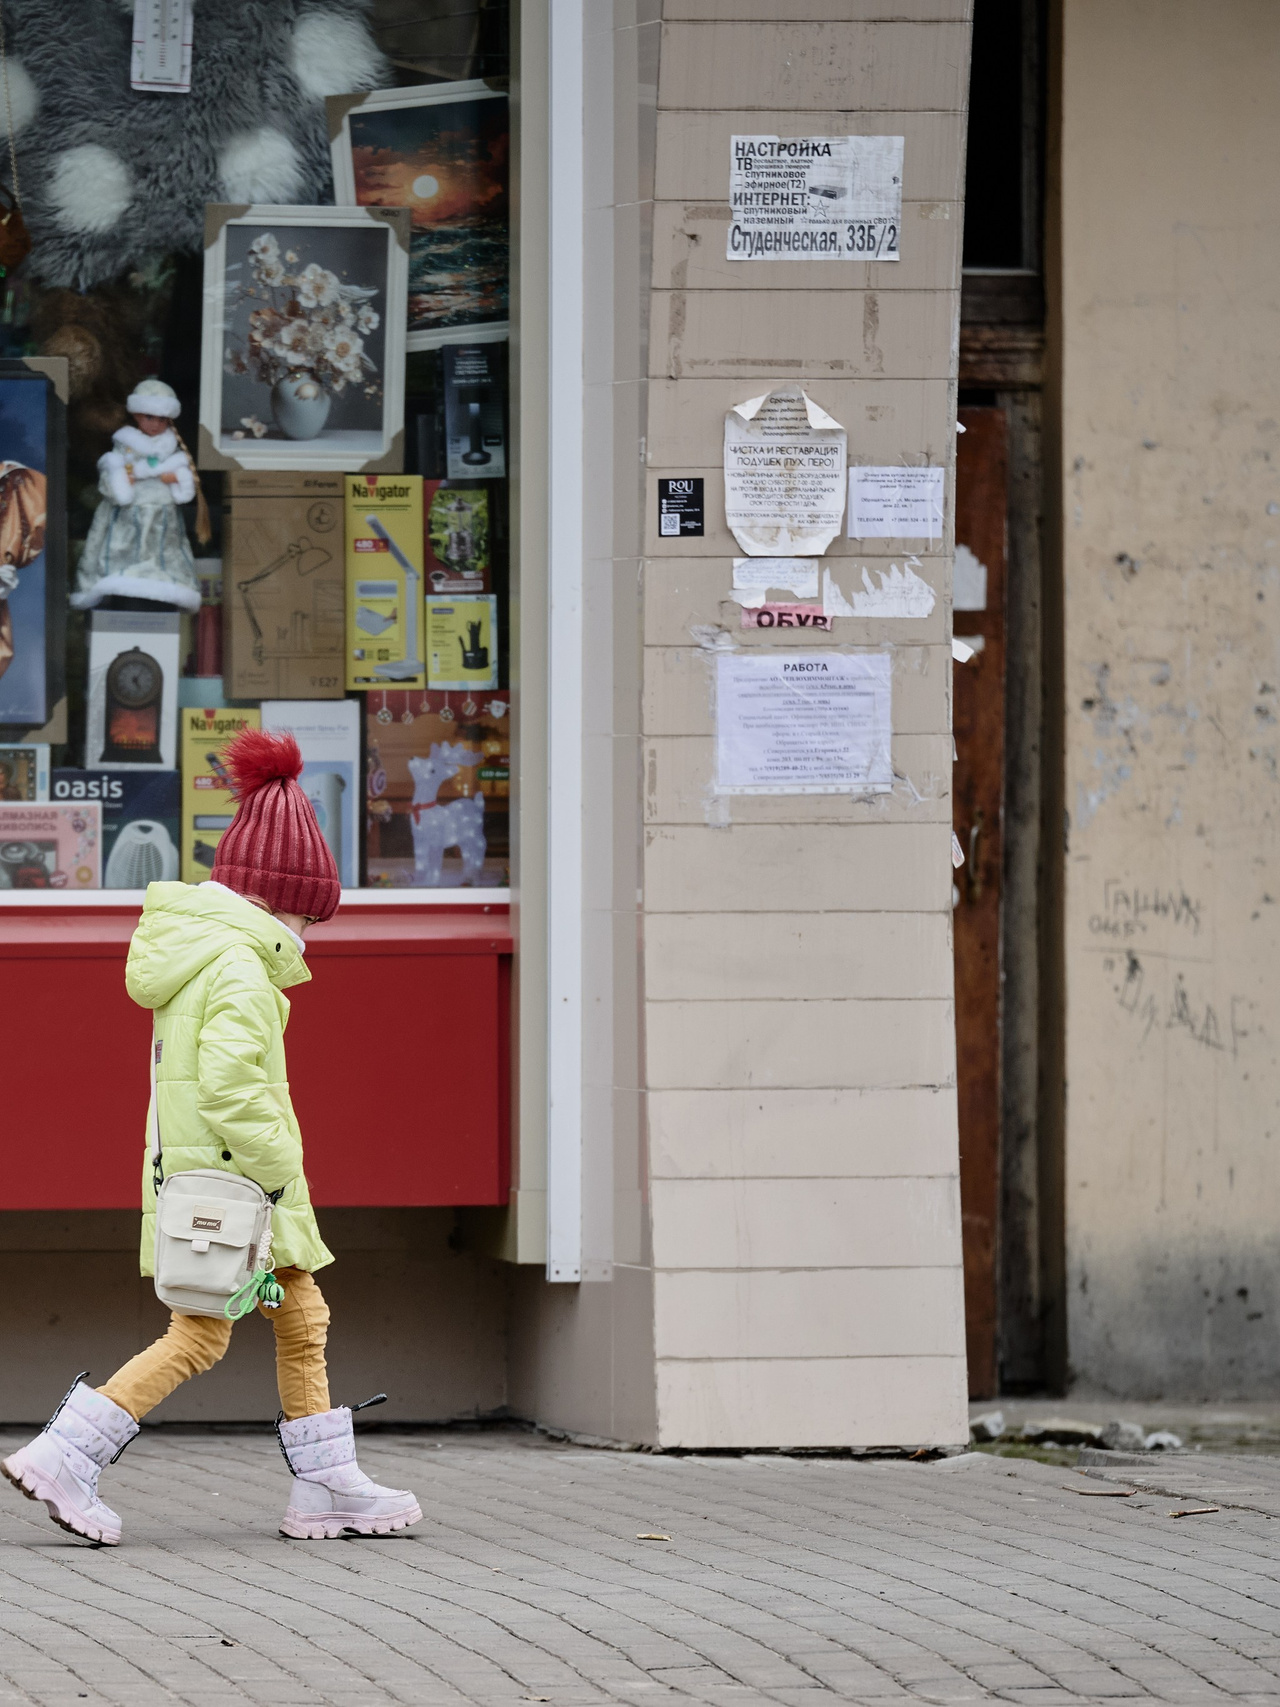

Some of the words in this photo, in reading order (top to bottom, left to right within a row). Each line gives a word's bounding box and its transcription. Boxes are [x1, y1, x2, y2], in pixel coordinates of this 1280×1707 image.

[735, 139, 832, 157] НАСТРОЙКА
[736, 157, 753, 171] ТВ
[745, 171, 807, 180] спутниковое
[733, 192, 811, 206] ИНТЕРНЕТ:
[743, 206, 808, 217] спутниковый
[743, 215, 794, 225] наземный
[731, 224, 842, 258] Студенческая,
[846, 224, 898, 258] 33Б/2
[729, 446, 764, 455] ЧИСТКА
[767, 447, 774, 455] И
[776, 447, 839, 456] РЕСТАВРАЦИЯ
[737, 457, 782, 467] ПОДУШЕК
[808, 458, 834, 468] ПЕРО)
[352, 484, 411, 501] Navigator
[668, 480, 694, 493] ROU
[783, 663, 828, 672] РАБОТА
[190, 717, 249, 734] Navigator
[55, 775, 123, 798] oasis
